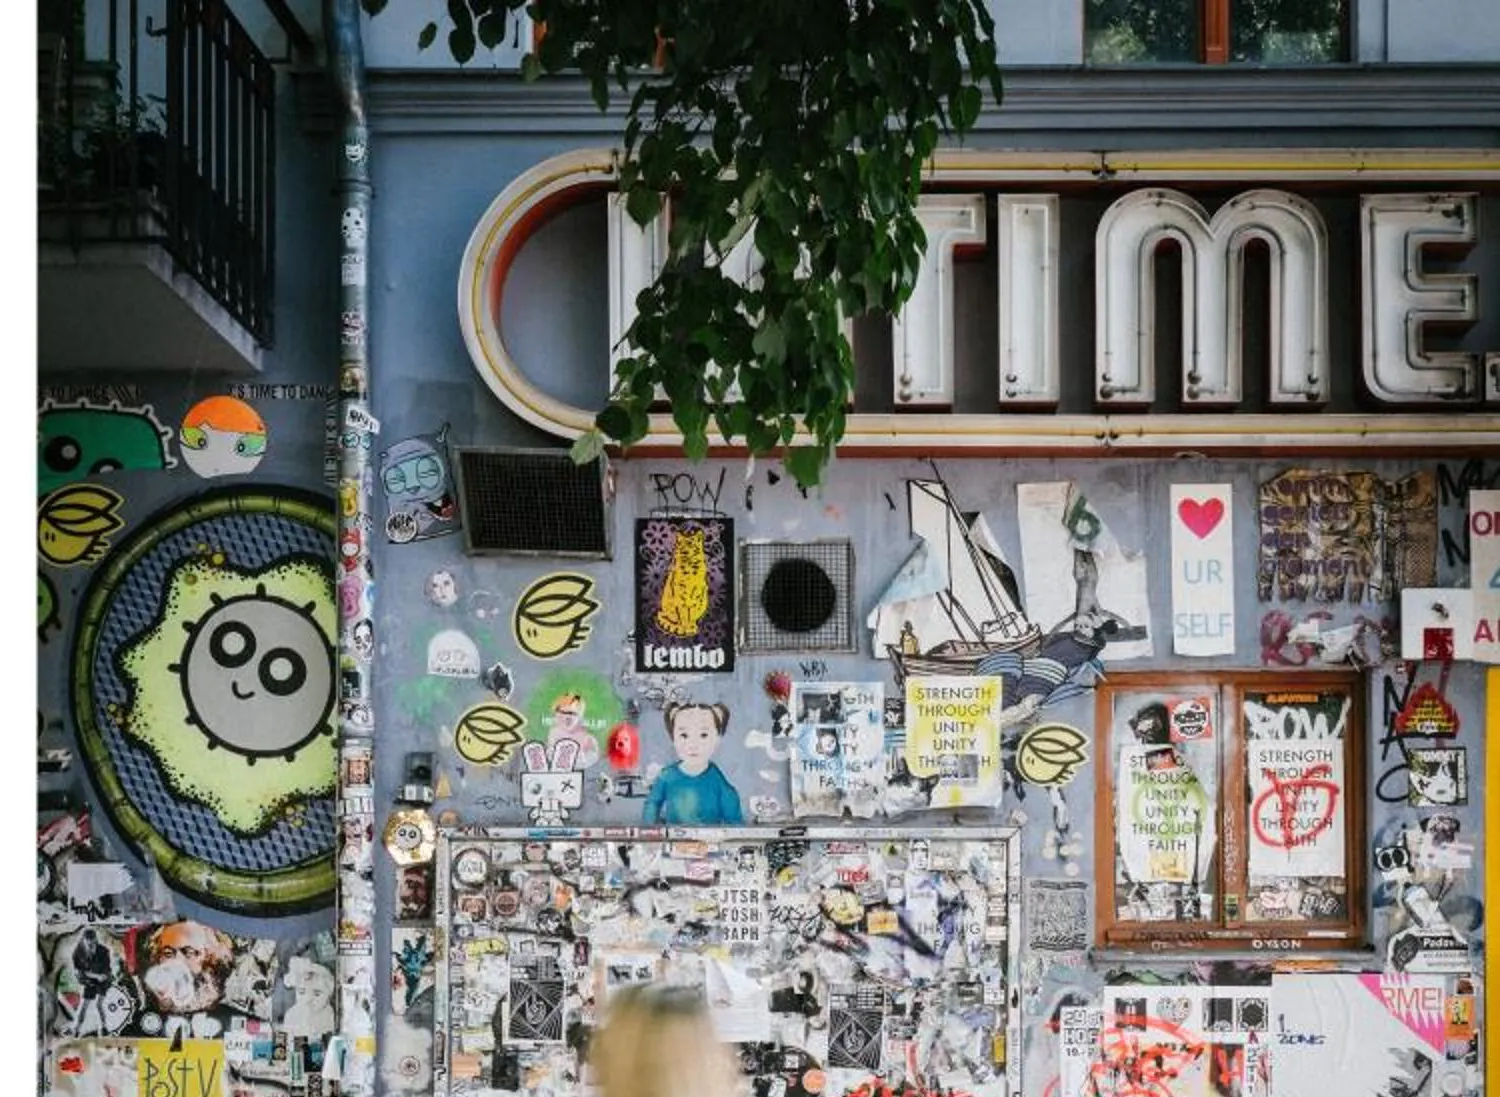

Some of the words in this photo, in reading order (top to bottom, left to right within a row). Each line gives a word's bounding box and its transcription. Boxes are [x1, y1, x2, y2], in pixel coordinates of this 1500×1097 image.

[649, 467, 727, 512] POW
[1183, 559, 1224, 584] UR
[1174, 612, 1232, 638] SELF
[917, 687, 991, 700] STRENGTH
[918, 703, 991, 717] THROUGH
[933, 721, 976, 734] UNITY
[933, 738, 977, 751] UNITY
[1259, 749, 1333, 762] STRENGTH
[1145, 788, 1188, 801] UNITY
[1145, 806, 1189, 818] UNITY
[1148, 840, 1187, 851] FAITH
